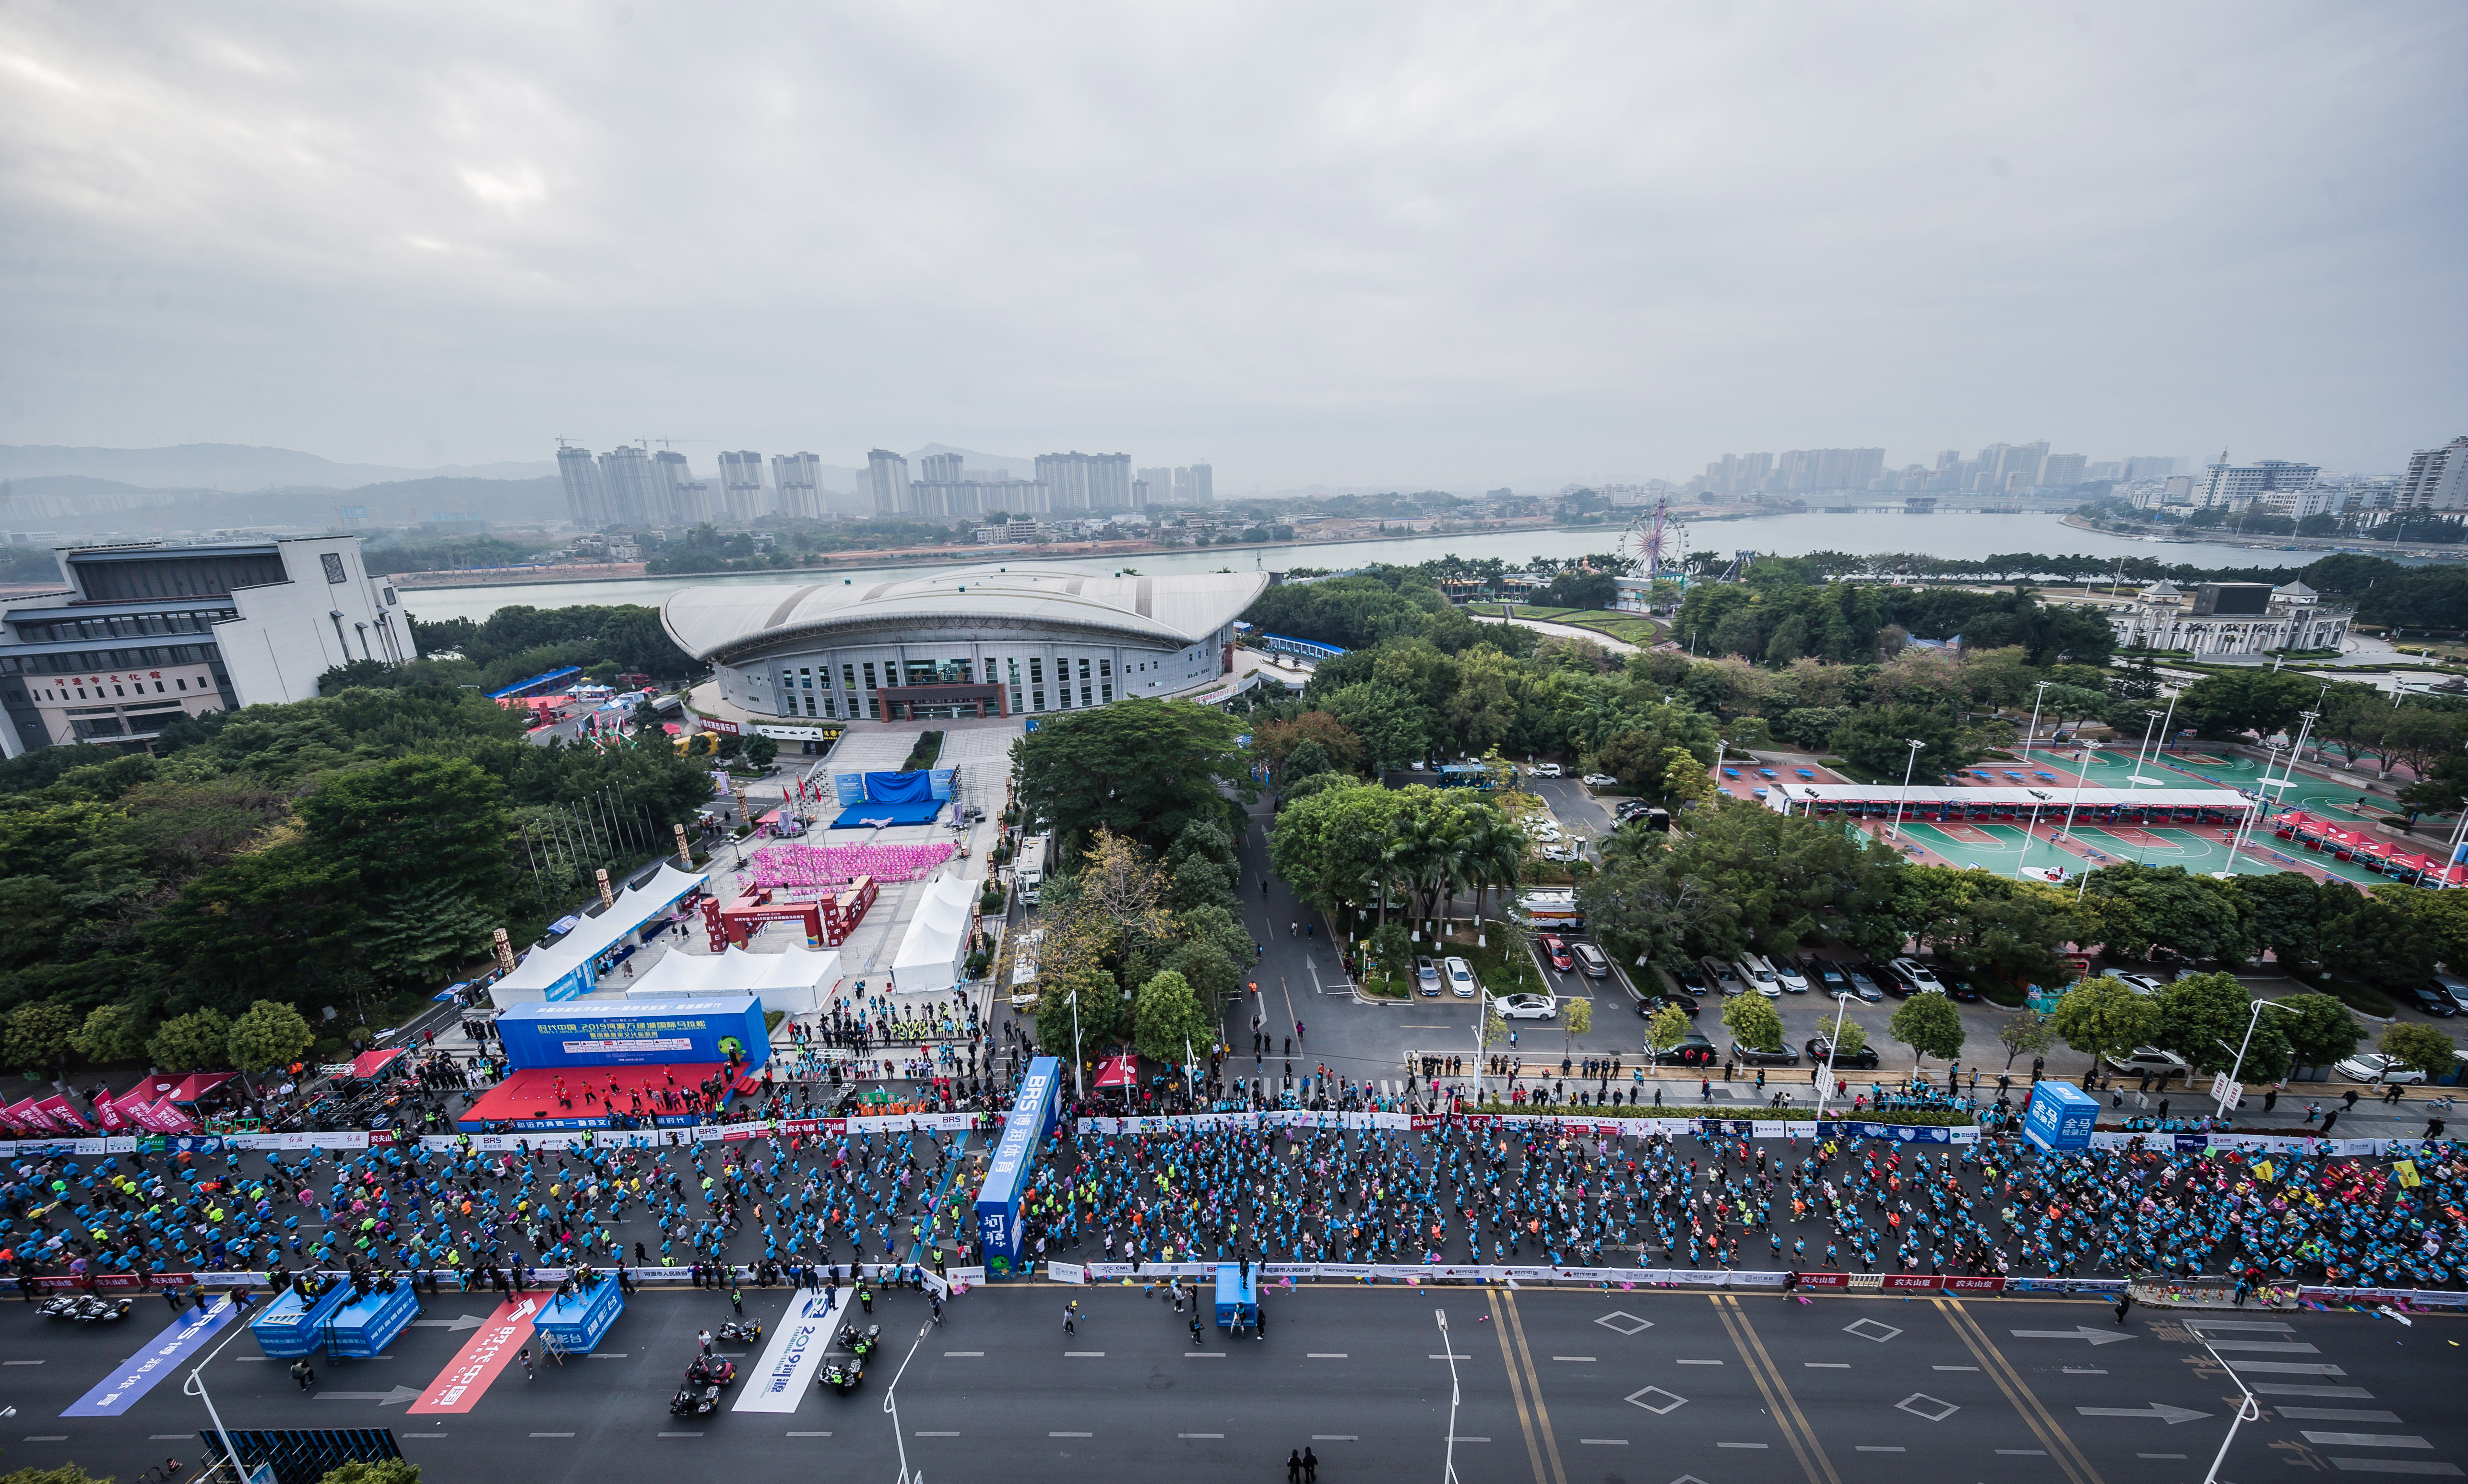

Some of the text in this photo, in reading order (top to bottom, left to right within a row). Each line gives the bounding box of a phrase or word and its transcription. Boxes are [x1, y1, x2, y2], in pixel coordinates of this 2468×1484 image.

[1019, 1076, 1046, 1111] BRS
[2032, 1108, 2055, 1131] 检录口
[2034, 1101, 2057, 1123] 全马
[2064, 1118, 2090, 1128] 全马
[995, 1113, 1033, 1174] 博润体育
[96, 1301, 232, 1407] BRS 博润体育
[430, 1327, 502, 1405] TIMES CHINA
[440, 1326, 517, 1405] 时代中国
[771, 1326, 815, 1393] 2019河源
